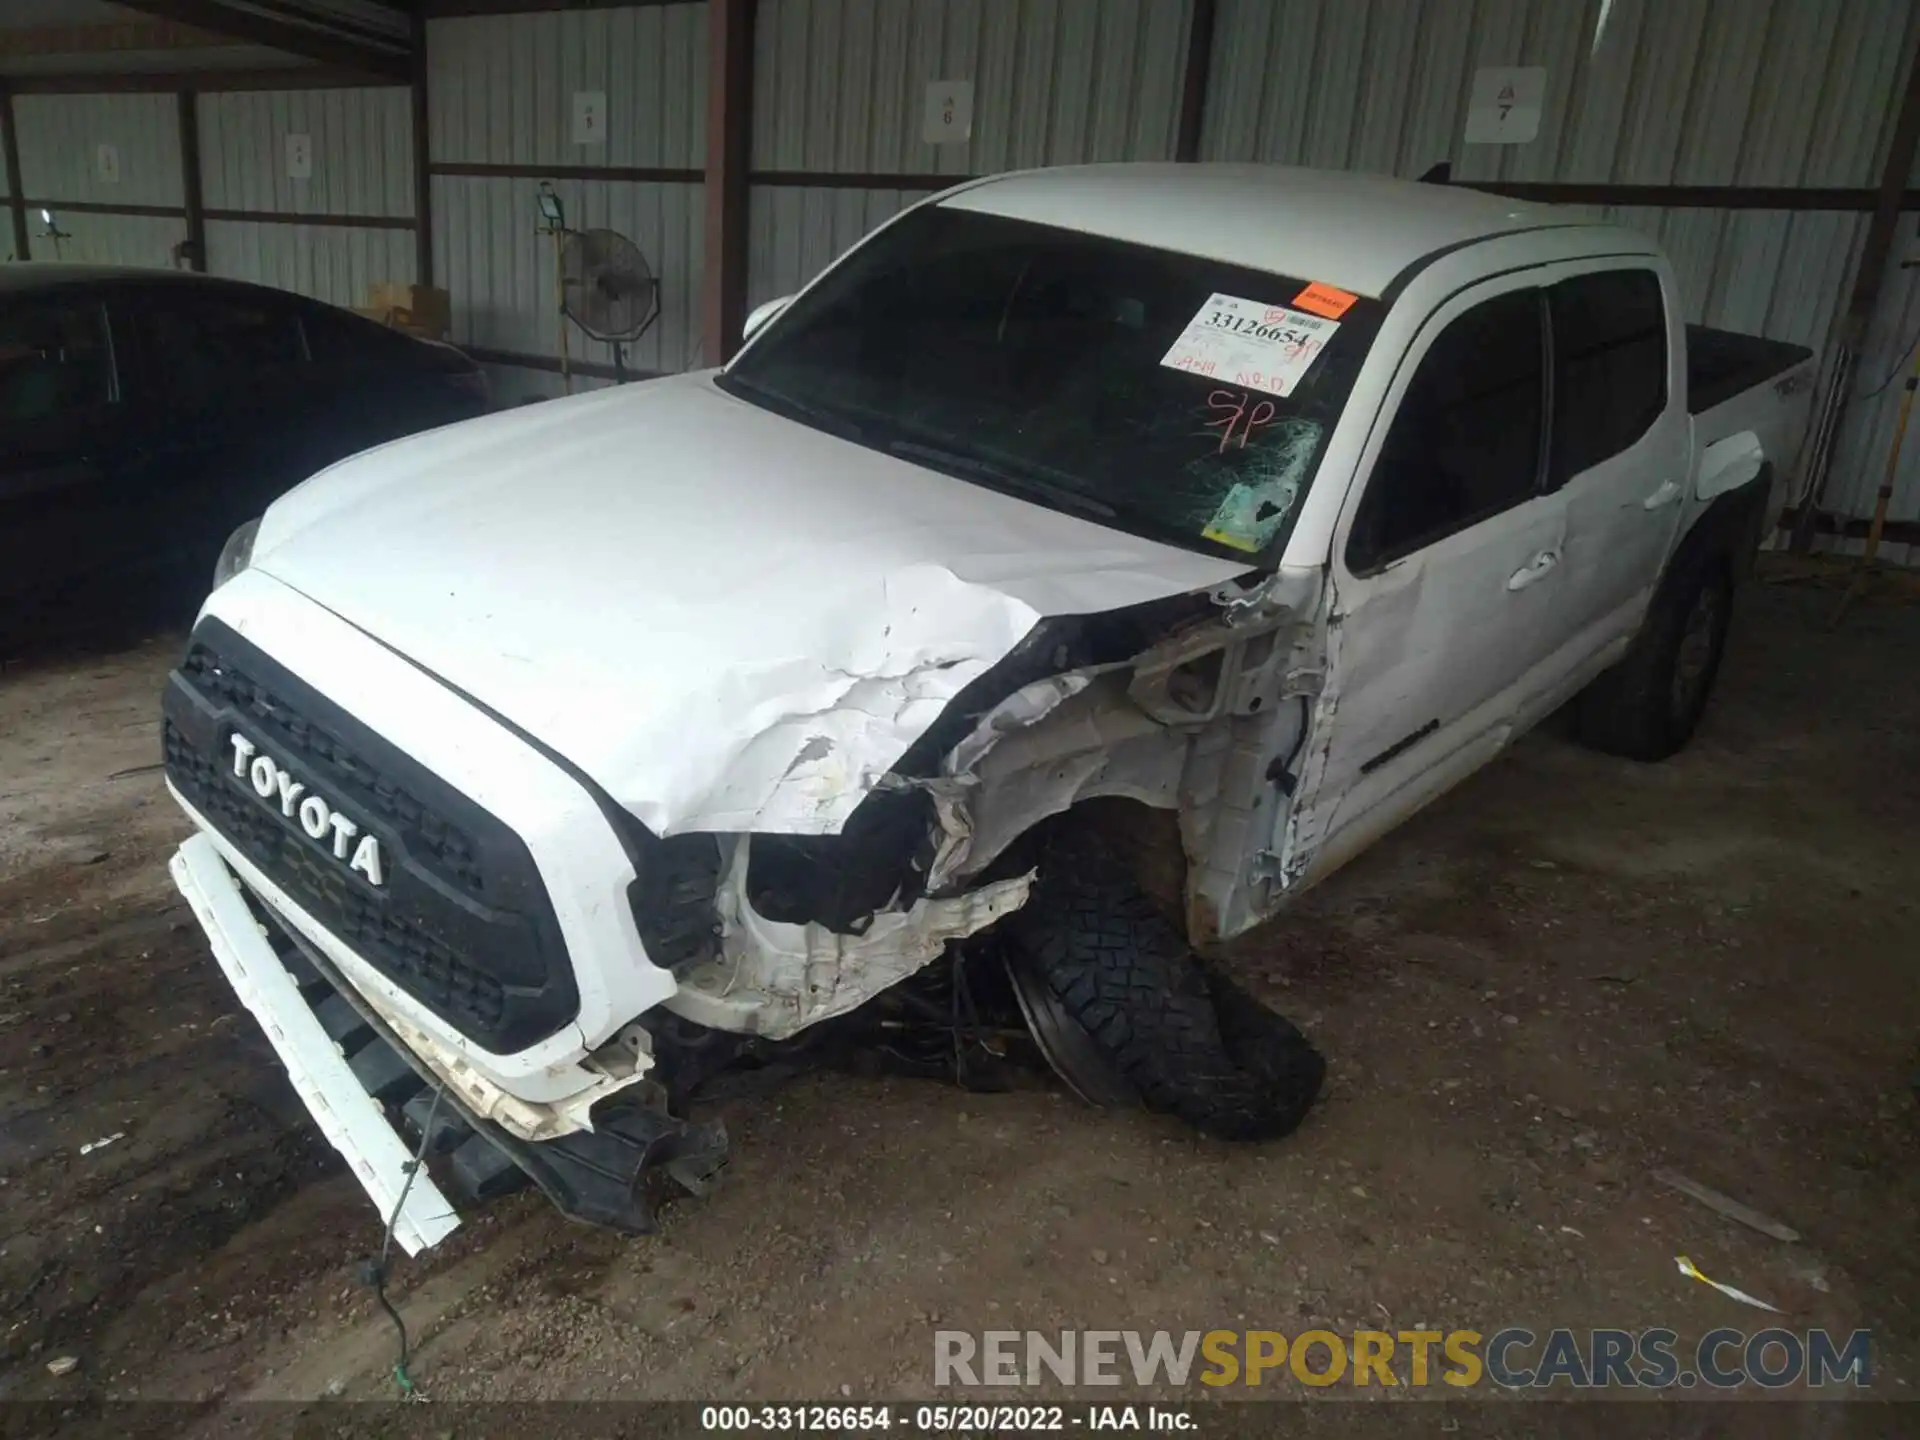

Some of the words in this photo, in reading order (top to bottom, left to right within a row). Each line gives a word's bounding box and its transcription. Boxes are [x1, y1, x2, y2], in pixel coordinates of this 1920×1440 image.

[1498, 103, 1514, 122] 7
[1204, 311, 1312, 347] 33126654
[230, 732, 383, 886] TOYOTA
